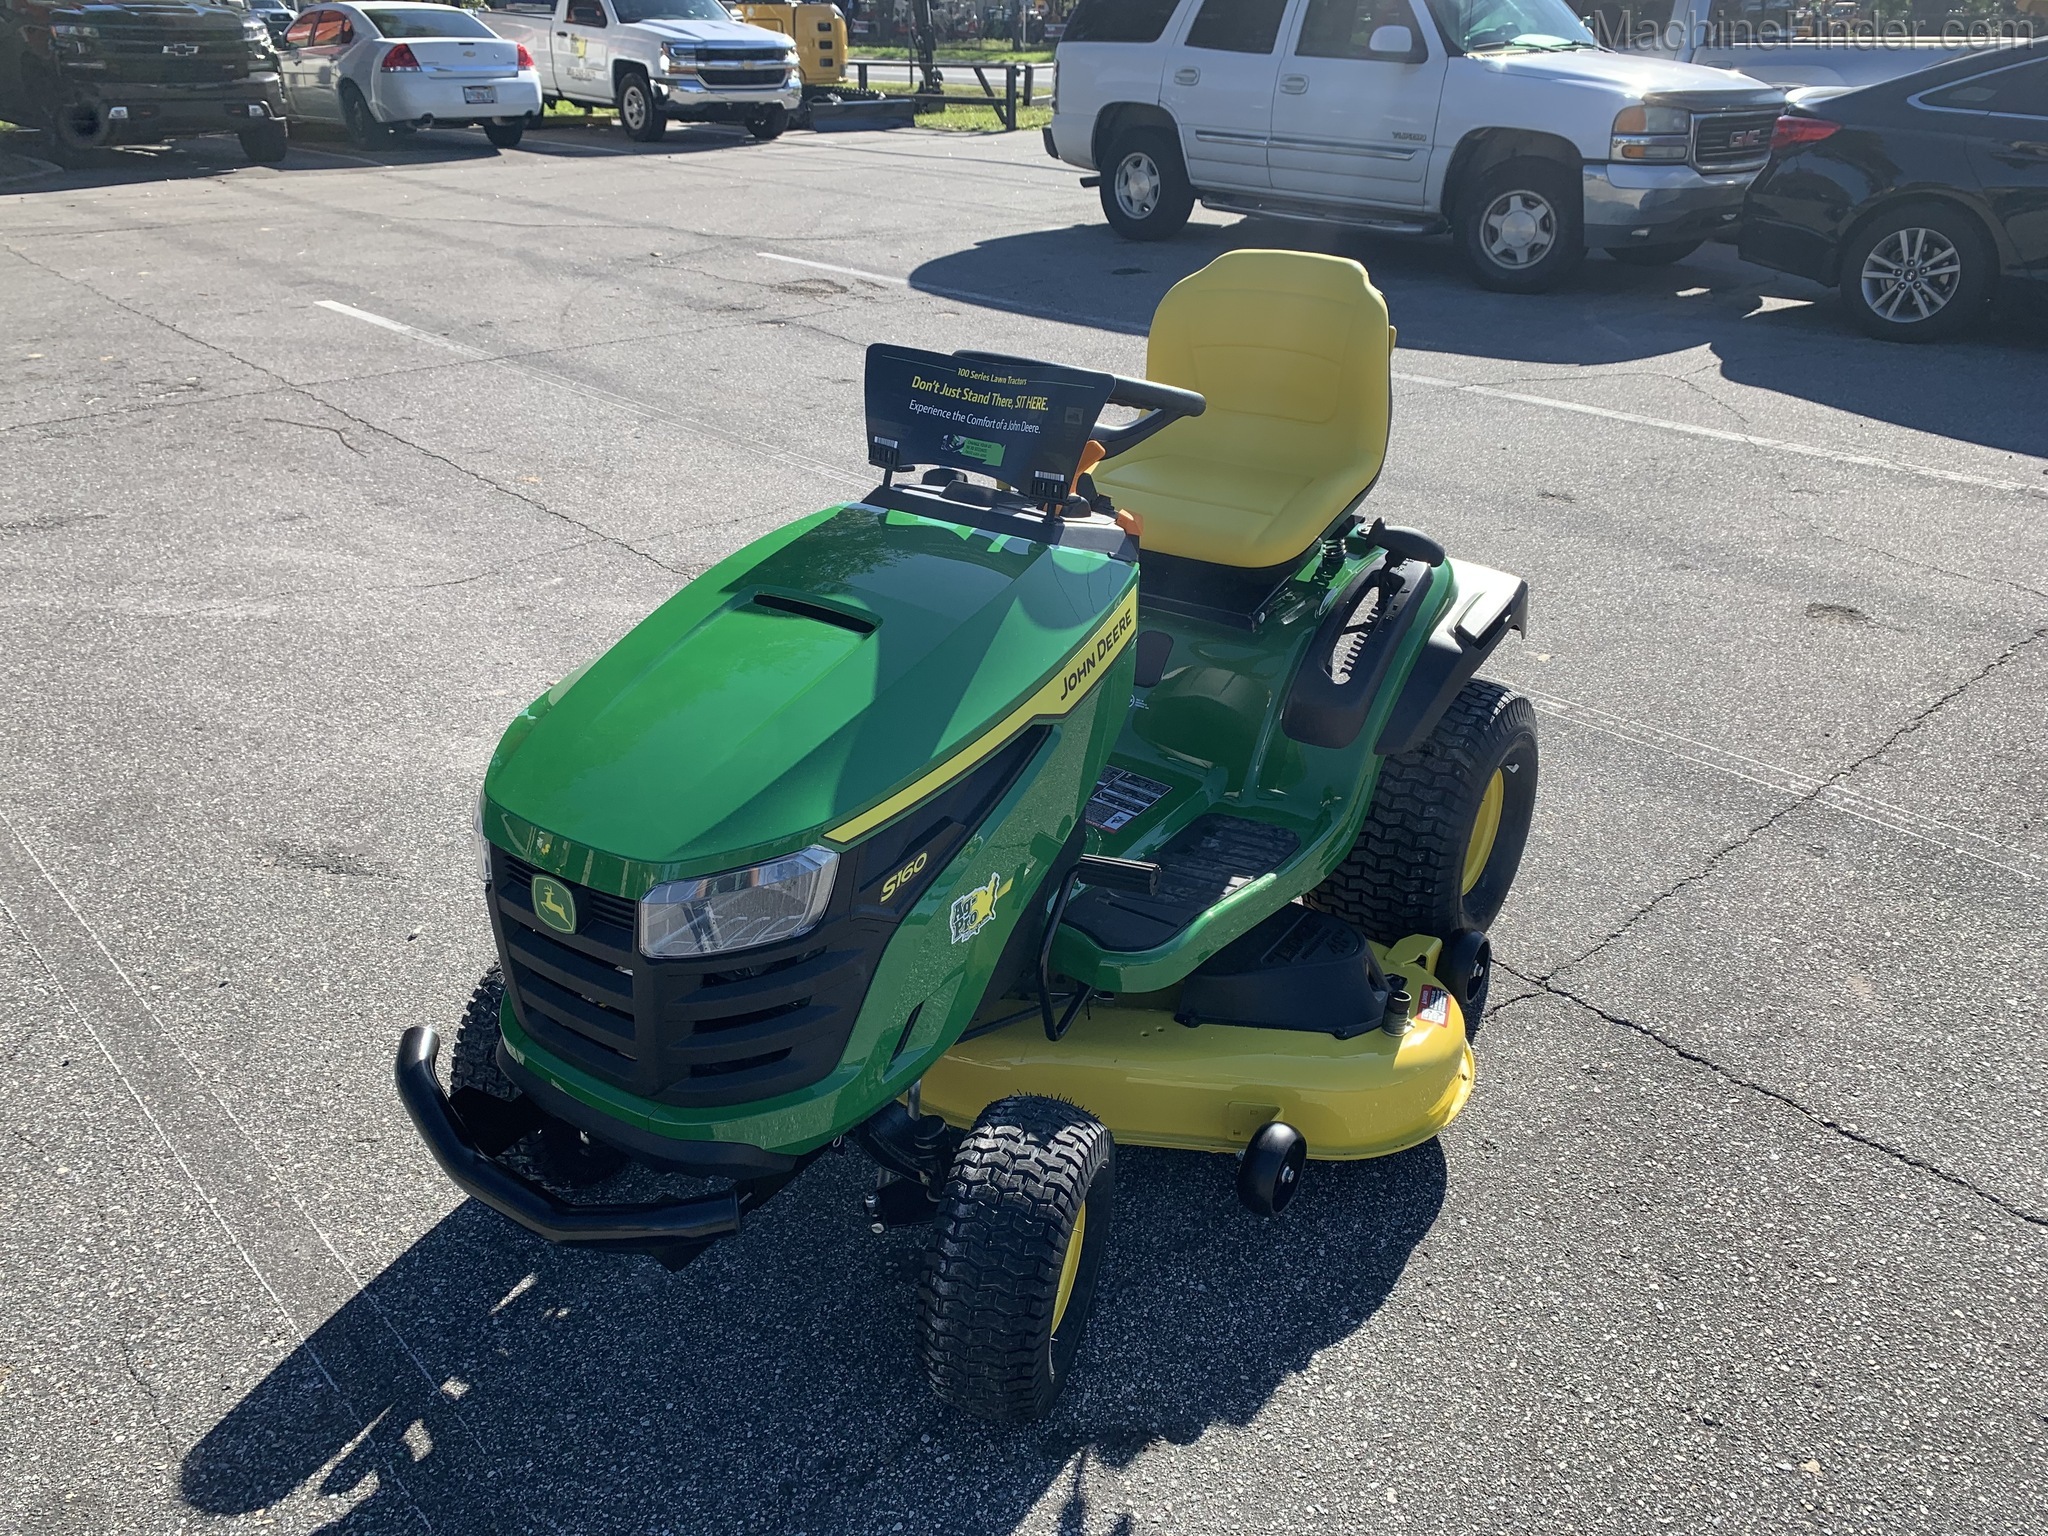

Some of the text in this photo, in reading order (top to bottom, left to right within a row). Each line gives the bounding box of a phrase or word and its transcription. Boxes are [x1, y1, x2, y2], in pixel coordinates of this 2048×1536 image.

[1729, 129, 1761, 147] GMC
[911, 376, 1049, 411] Don't Just Stand There, SIT HERE.
[957, 368, 1028, 386] 100 Series Lawn Tractors
[909, 400, 952, 419] Experience
[952, 410, 966, 423] the
[966, 413, 996, 429] Comfort
[996, 418, 1004, 430] of
[1007, 419, 1021, 431] John
[1021, 421, 1041, 434] Deere.
[1061, 608, 1132, 701] JOHN DEERE
[880, 852, 928, 904] S160
[954, 910, 978, 940] Pro
